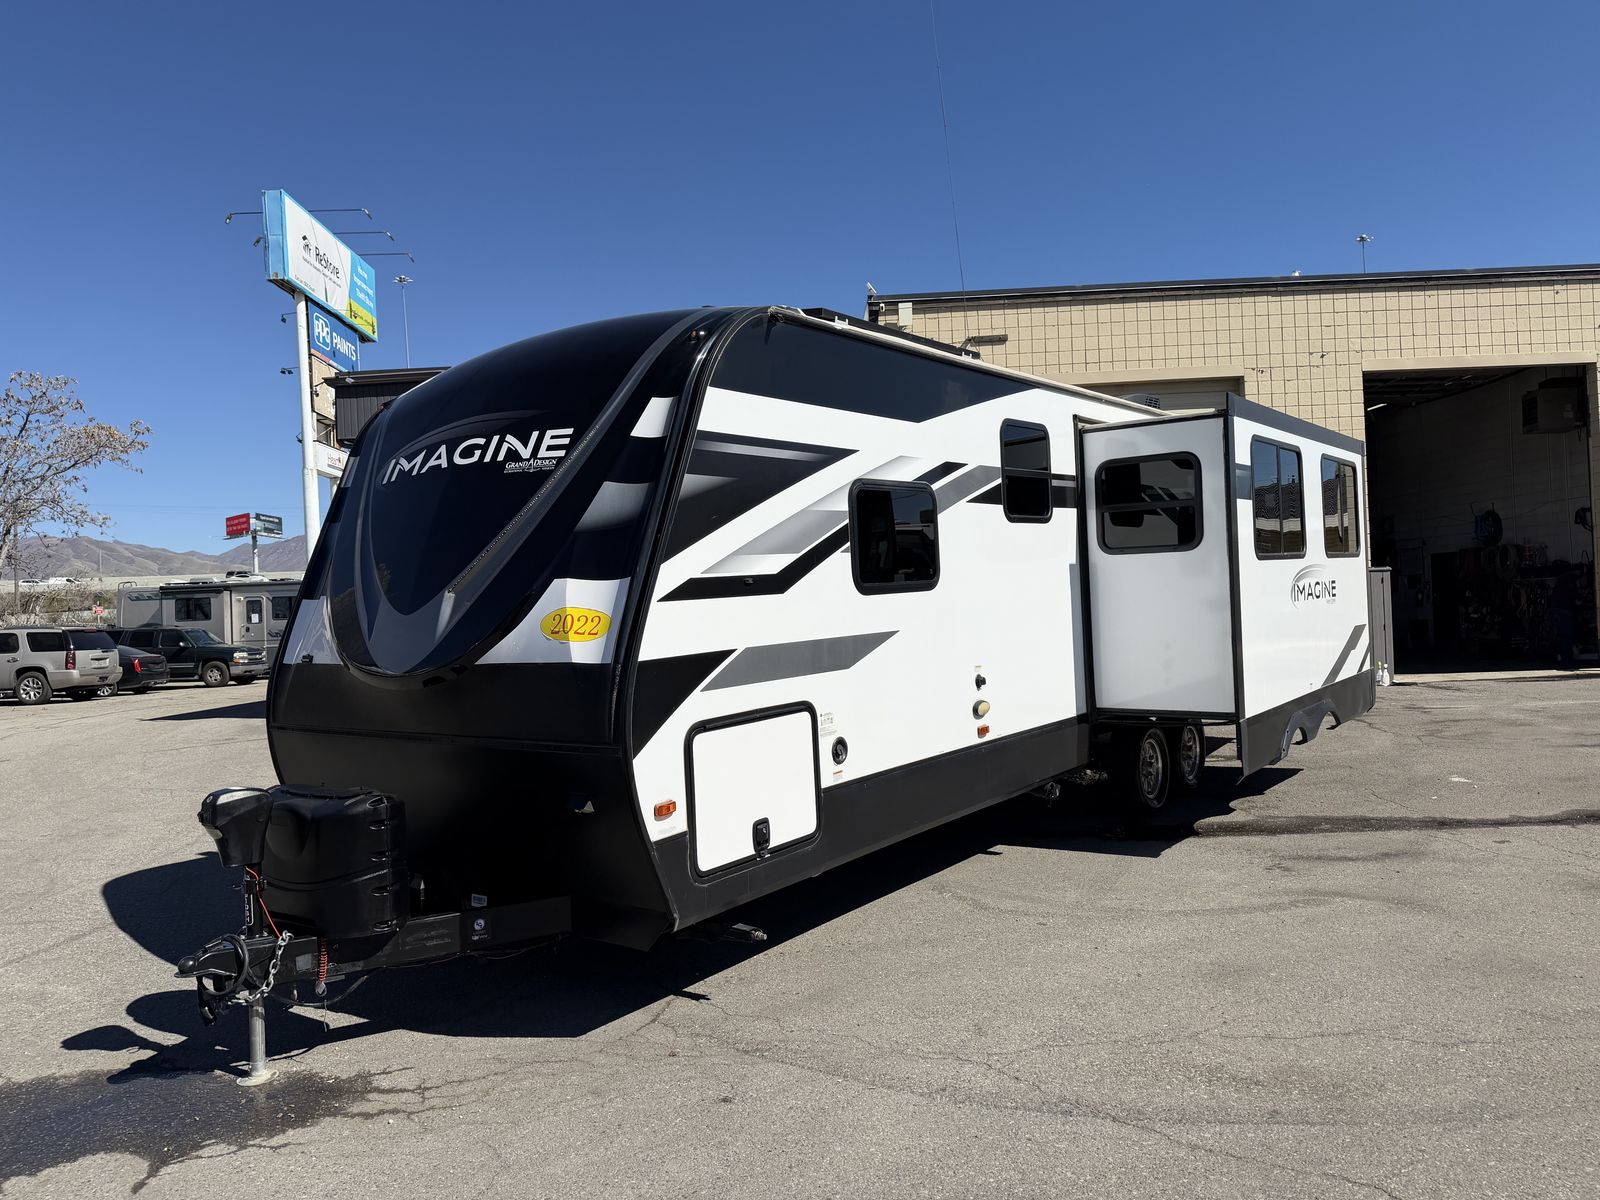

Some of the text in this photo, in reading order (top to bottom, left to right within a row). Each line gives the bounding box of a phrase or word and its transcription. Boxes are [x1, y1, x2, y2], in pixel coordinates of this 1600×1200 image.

[315, 246, 340, 279] ReStore
[314, 317, 331, 344] PPG
[332, 331, 356, 361] PAINTS
[381, 427, 574, 485] IMAGINE
[505, 461, 529, 470] GRAND
[534, 458, 557, 467] DESIGN
[1293, 580, 1337, 602] IMAGINE
[550, 613, 602, 636] 2022
